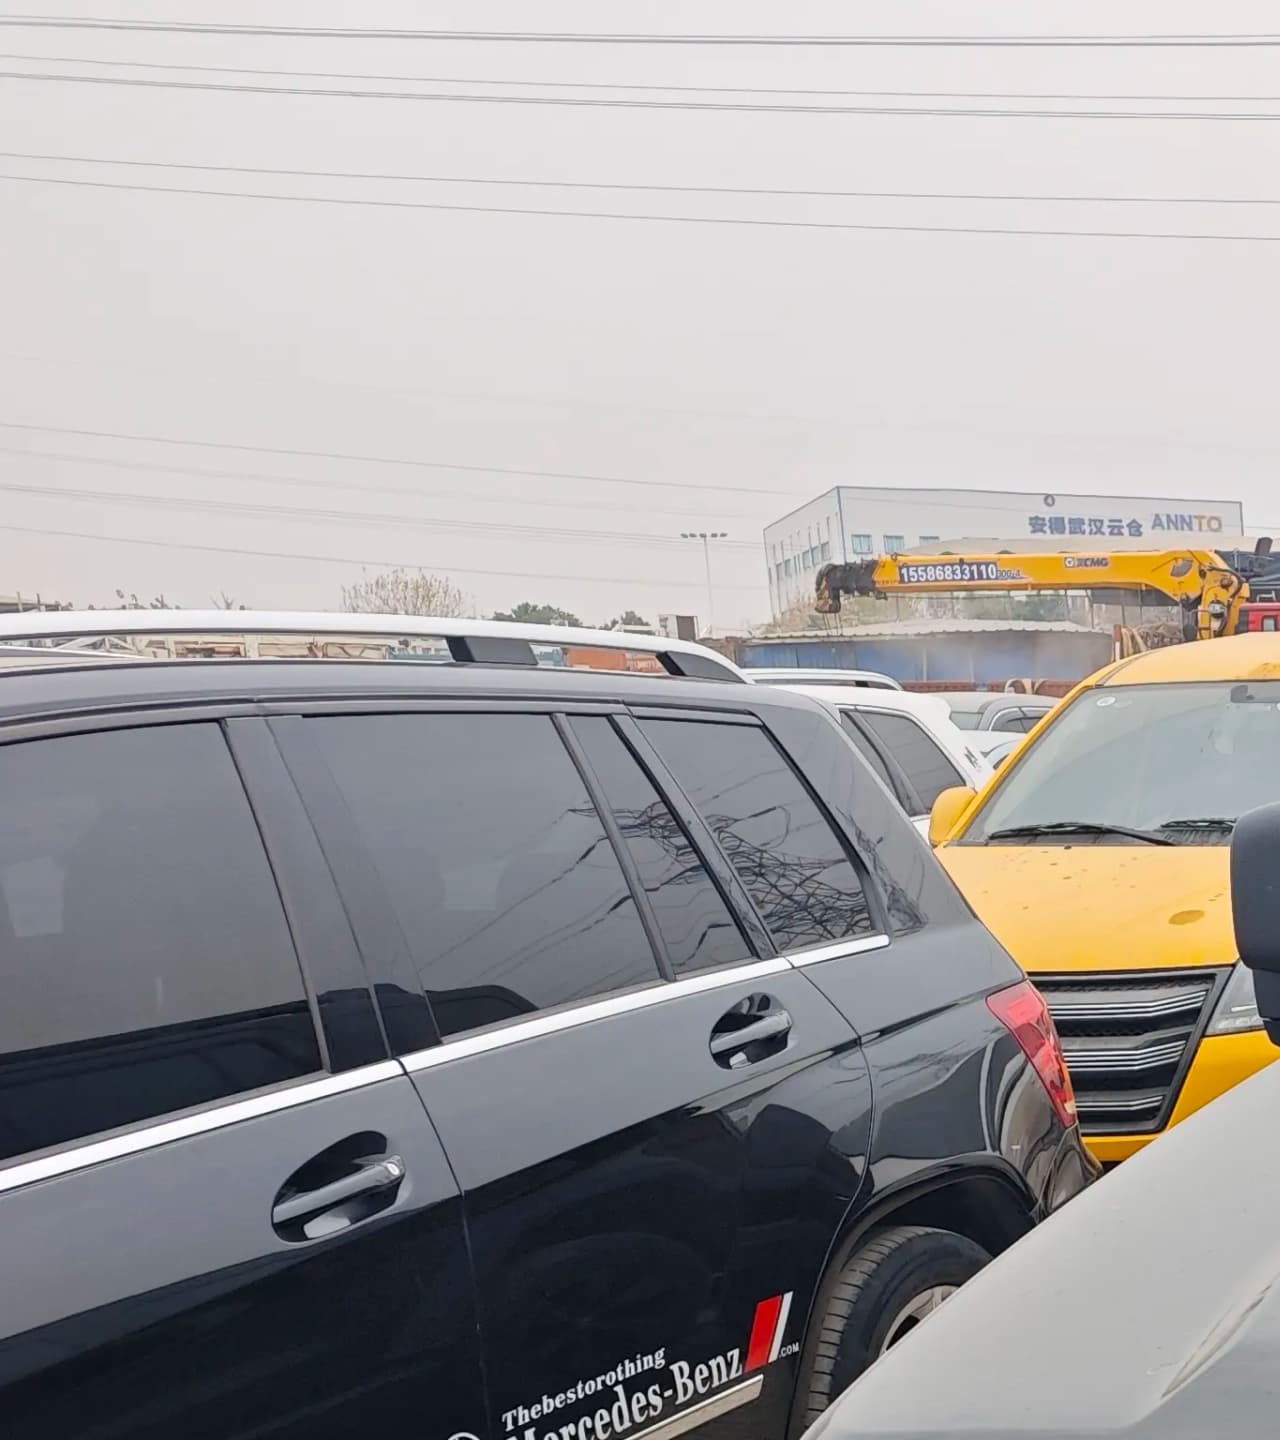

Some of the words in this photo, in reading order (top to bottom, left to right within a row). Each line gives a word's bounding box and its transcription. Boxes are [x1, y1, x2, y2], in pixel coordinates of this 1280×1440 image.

[1028, 515, 1144, 538] 安得武汉云仓
[1151, 513, 1223, 533] ANNTO
[901, 564, 997, 583] 15586833110
[501, 1347, 666, 1432] Thebestorothing
